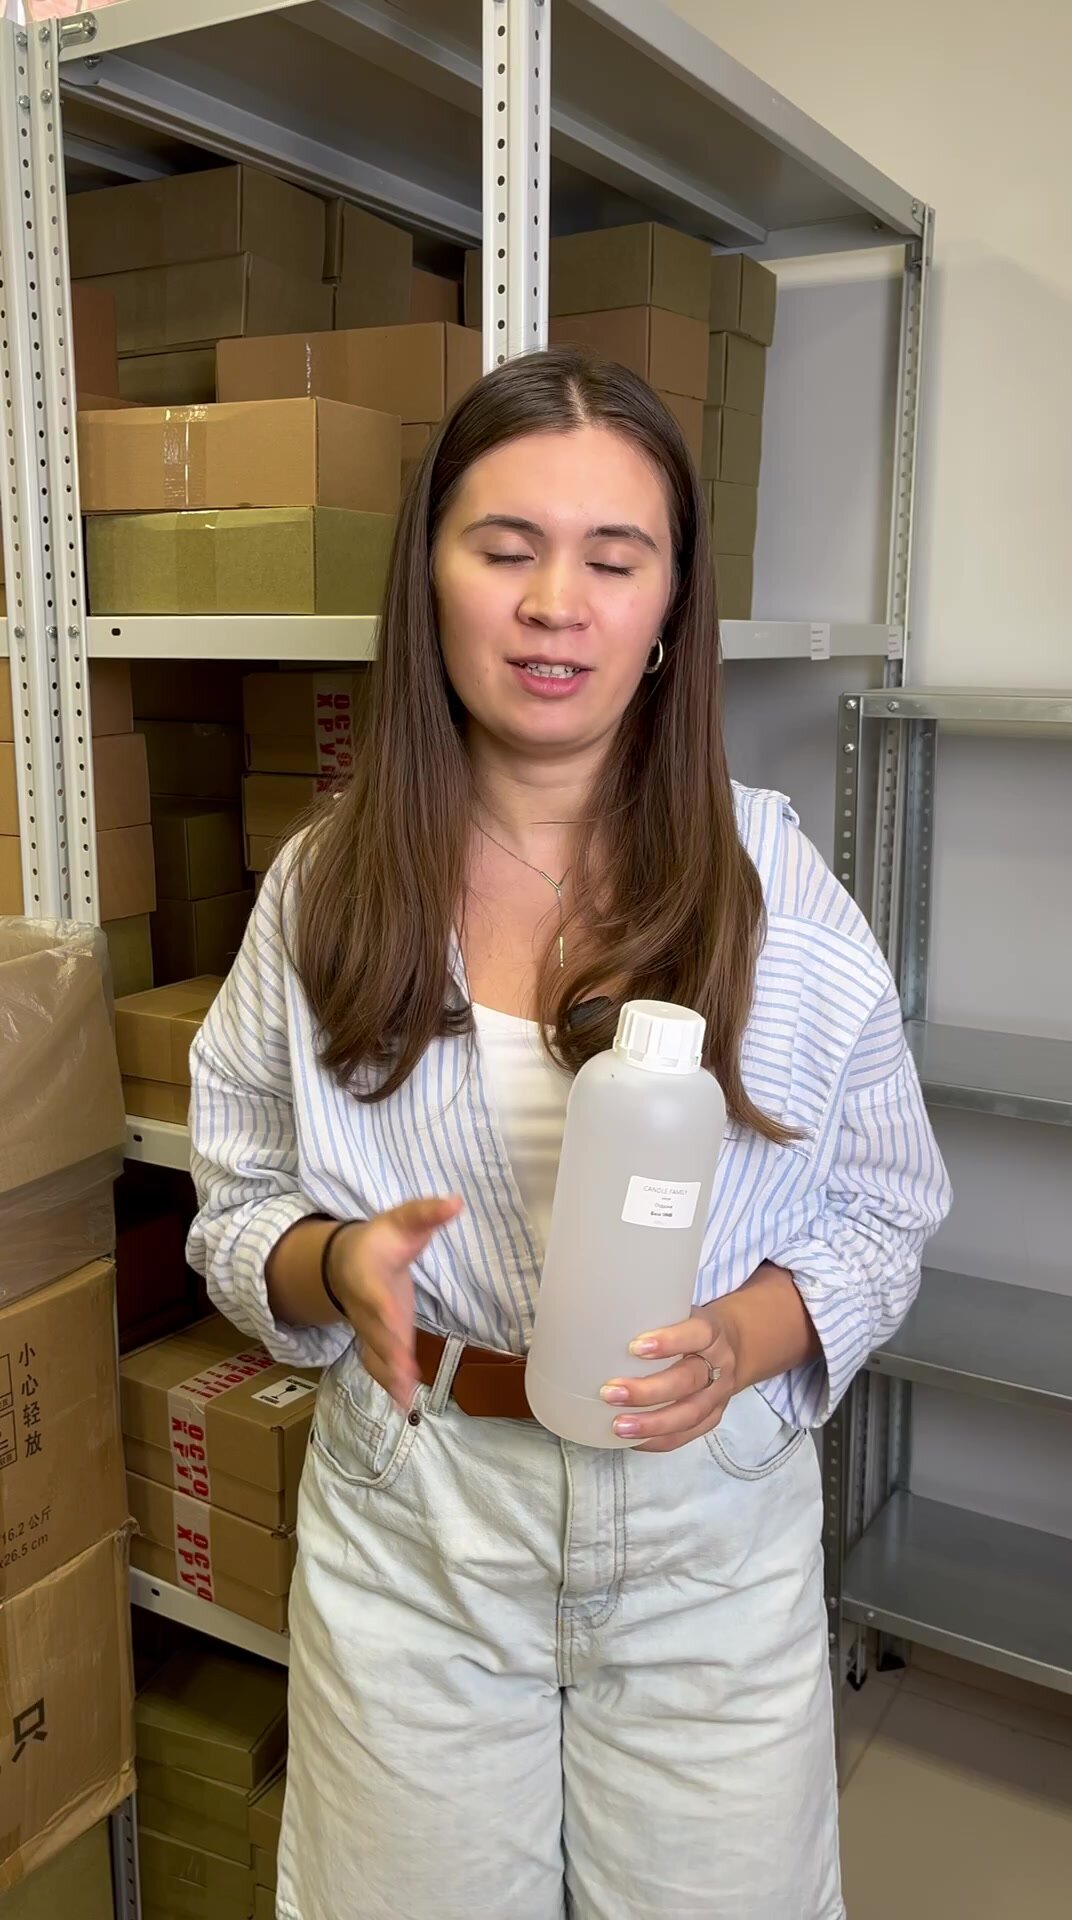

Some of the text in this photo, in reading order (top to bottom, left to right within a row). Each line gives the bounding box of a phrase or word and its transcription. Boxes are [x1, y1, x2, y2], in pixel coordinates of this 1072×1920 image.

[18, 1343, 42, 1458] 小心轻放
[2, 1505, 51, 1544] 16.2 公斤
[31, 1534, 48, 1550] cm
[12, 1697, 48, 1763] 只
